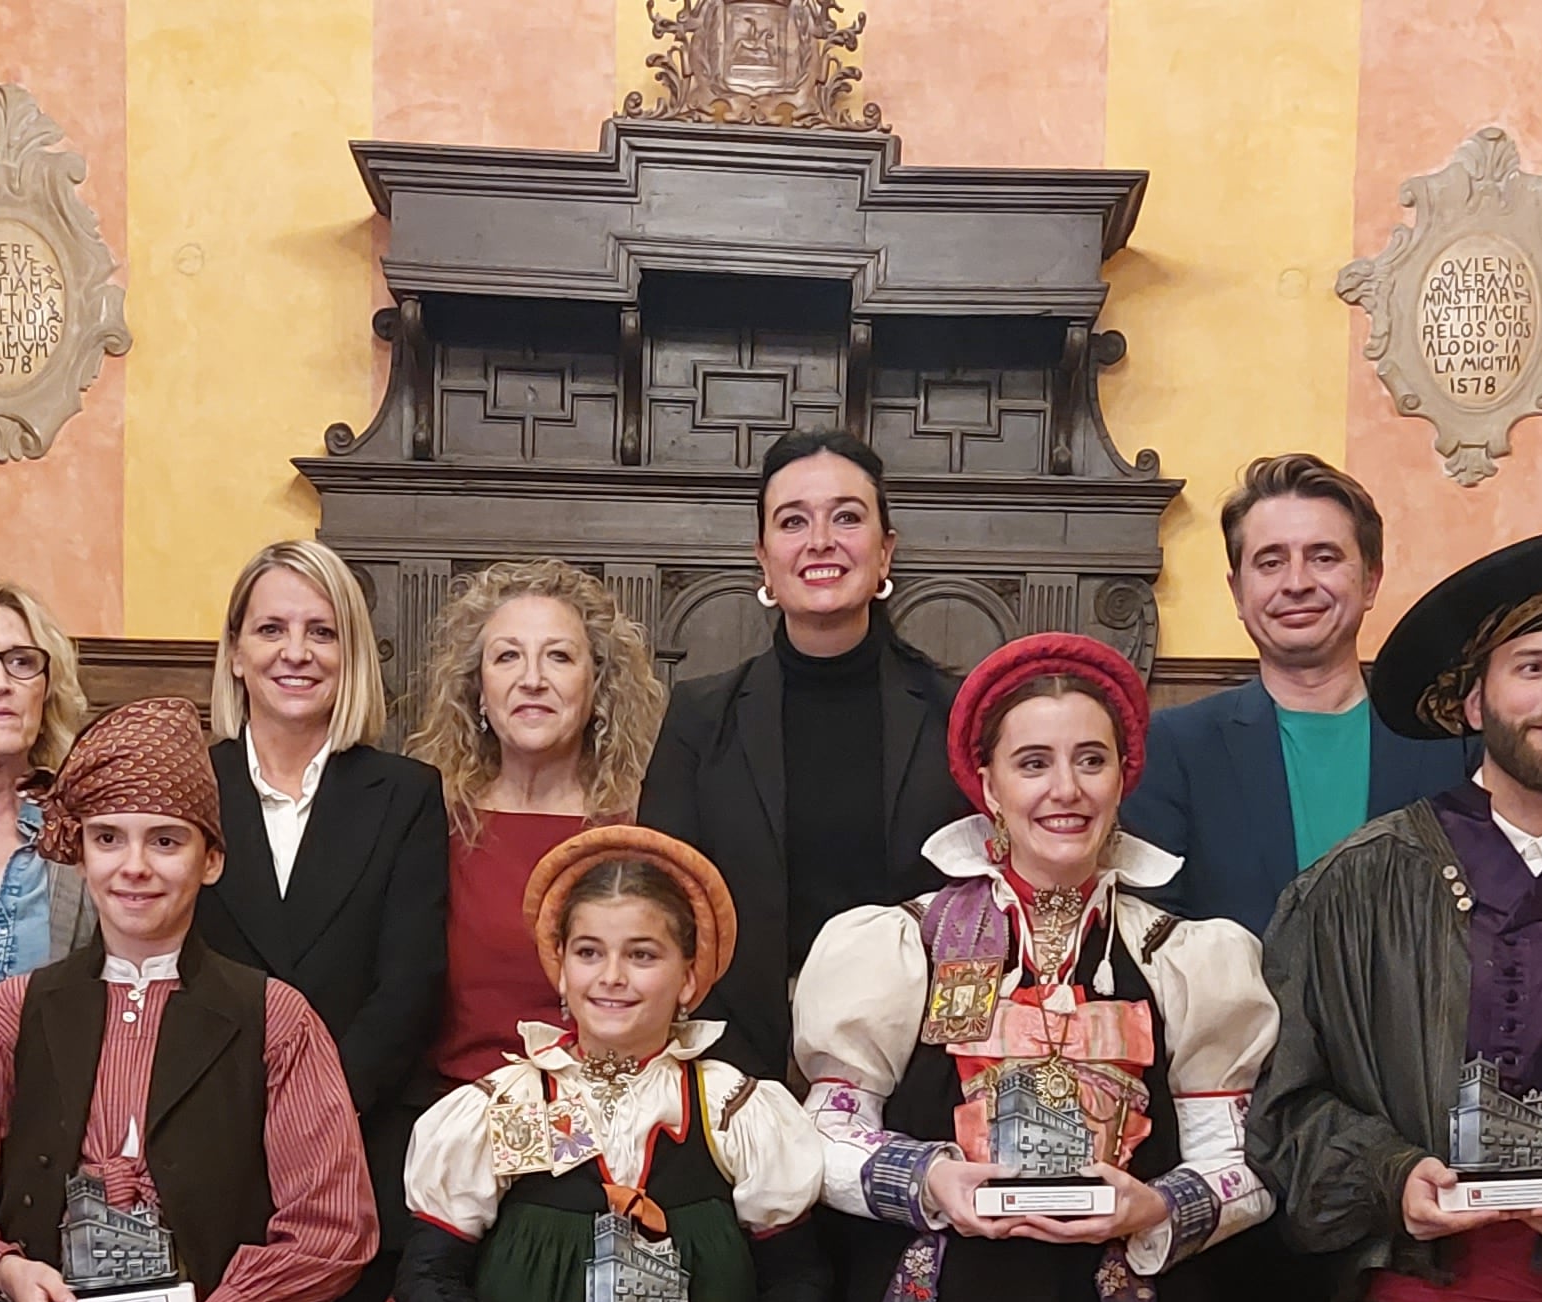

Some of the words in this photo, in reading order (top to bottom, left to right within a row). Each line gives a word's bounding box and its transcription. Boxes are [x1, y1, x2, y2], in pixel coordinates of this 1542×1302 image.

[1441, 257, 1511, 276] QVIEN
[1422, 321, 1486, 340] RELOS
[1434, 357, 1455, 373] LA
[1450, 376, 1496, 395] 1578
